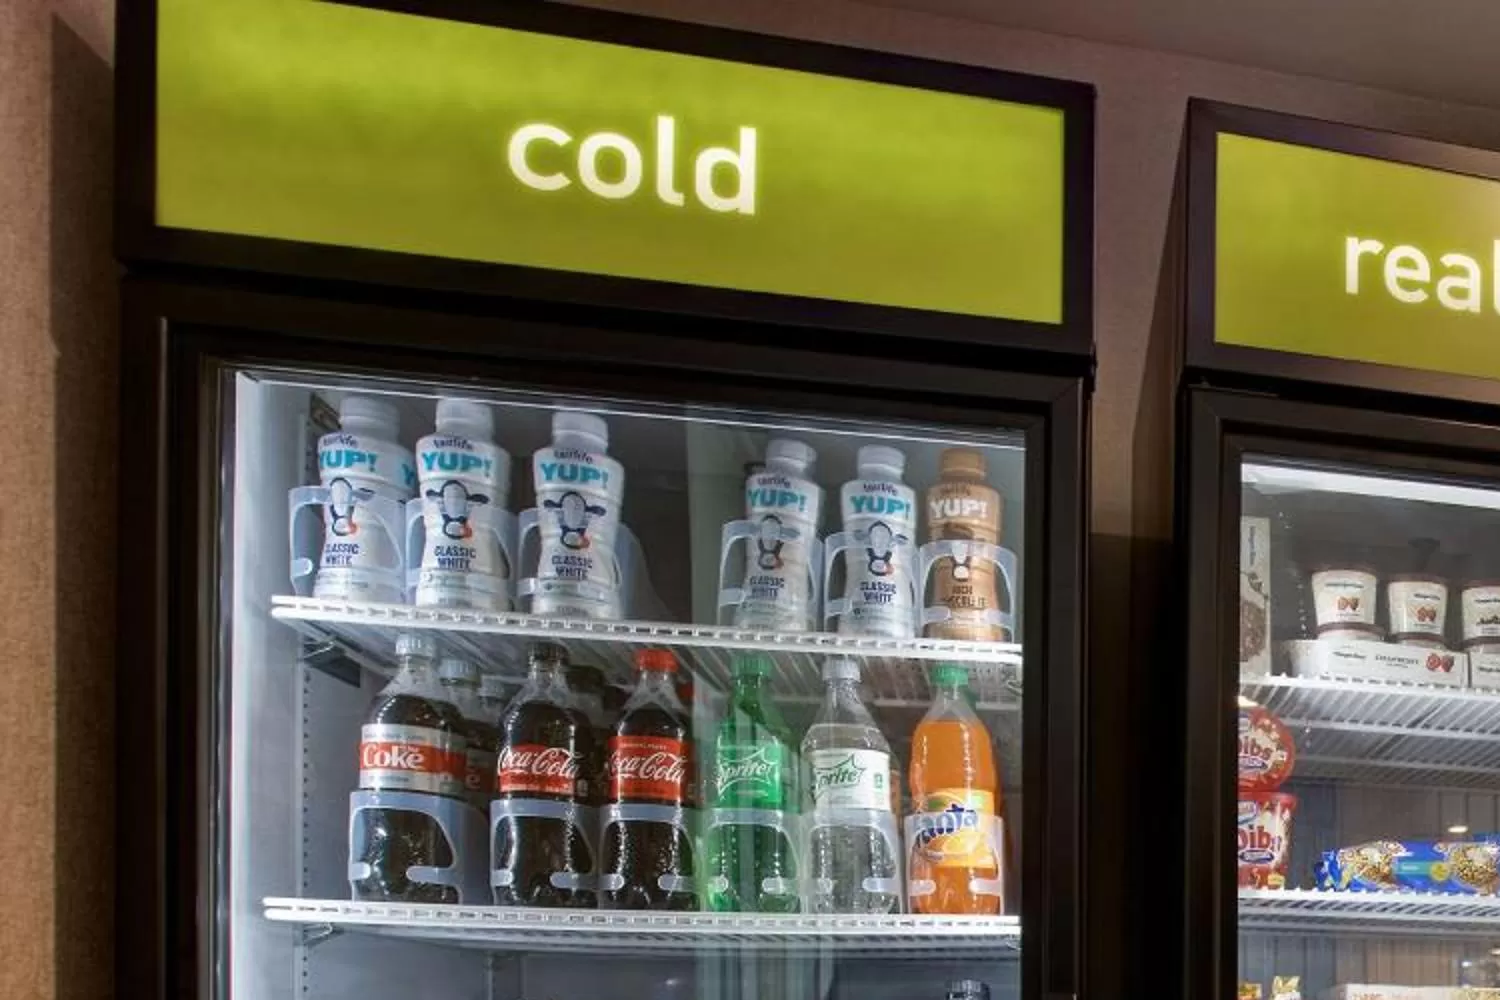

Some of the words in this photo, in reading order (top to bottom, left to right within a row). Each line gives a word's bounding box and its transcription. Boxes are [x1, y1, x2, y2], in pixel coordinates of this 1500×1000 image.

[507, 114, 757, 215] cold
[318, 449, 377, 473] YUP!
[421, 452, 493, 479] YUP!
[539, 462, 609, 490] YUP!
[747, 487, 807, 513] YUP!
[850, 495, 912, 520] YUP!
[929, 499, 988, 519] YUP!
[434, 546, 477, 559] CLASSIC
[437, 556, 473, 572] WHITE
[552, 554, 594, 569] CLASSIC
[555, 565, 590, 582] WHITE
[363, 741, 424, 770] Coke
